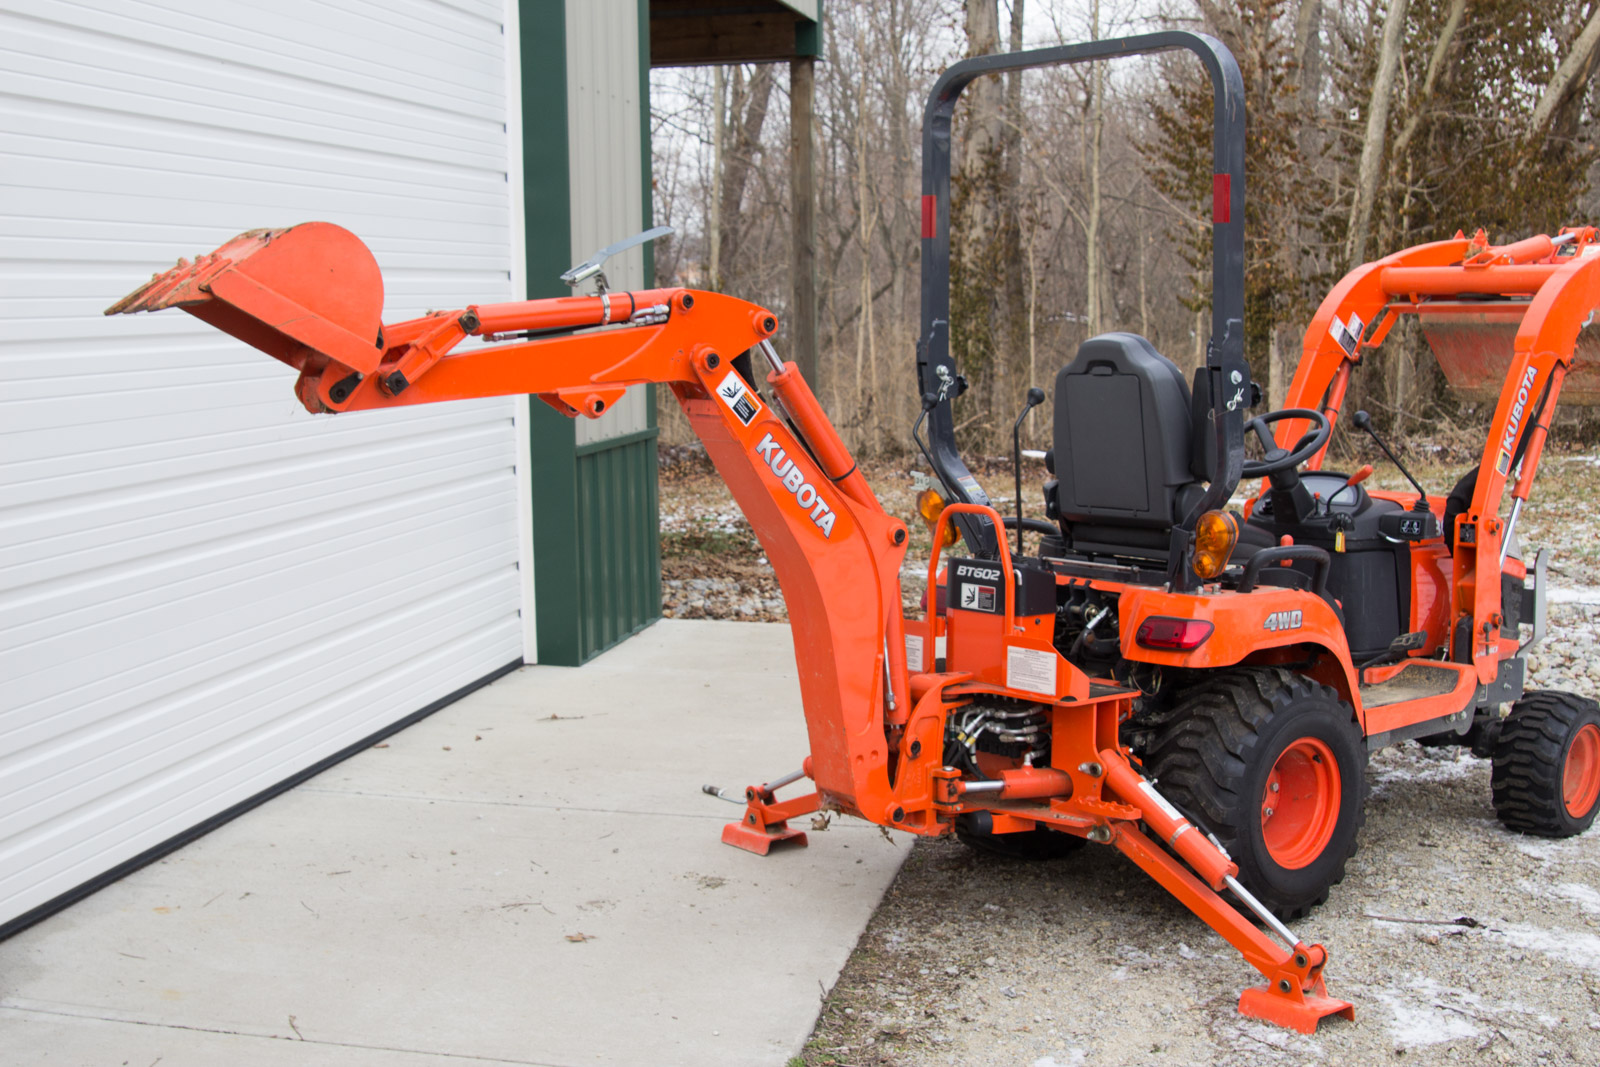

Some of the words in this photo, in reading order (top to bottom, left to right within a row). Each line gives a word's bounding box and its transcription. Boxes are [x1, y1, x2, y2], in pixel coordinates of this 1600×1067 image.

[1503, 365, 1538, 451] KUBOTA
[755, 432, 836, 539] KUBOTA
[957, 565, 1001, 581] BT602
[1263, 609, 1302, 632] 4WD
